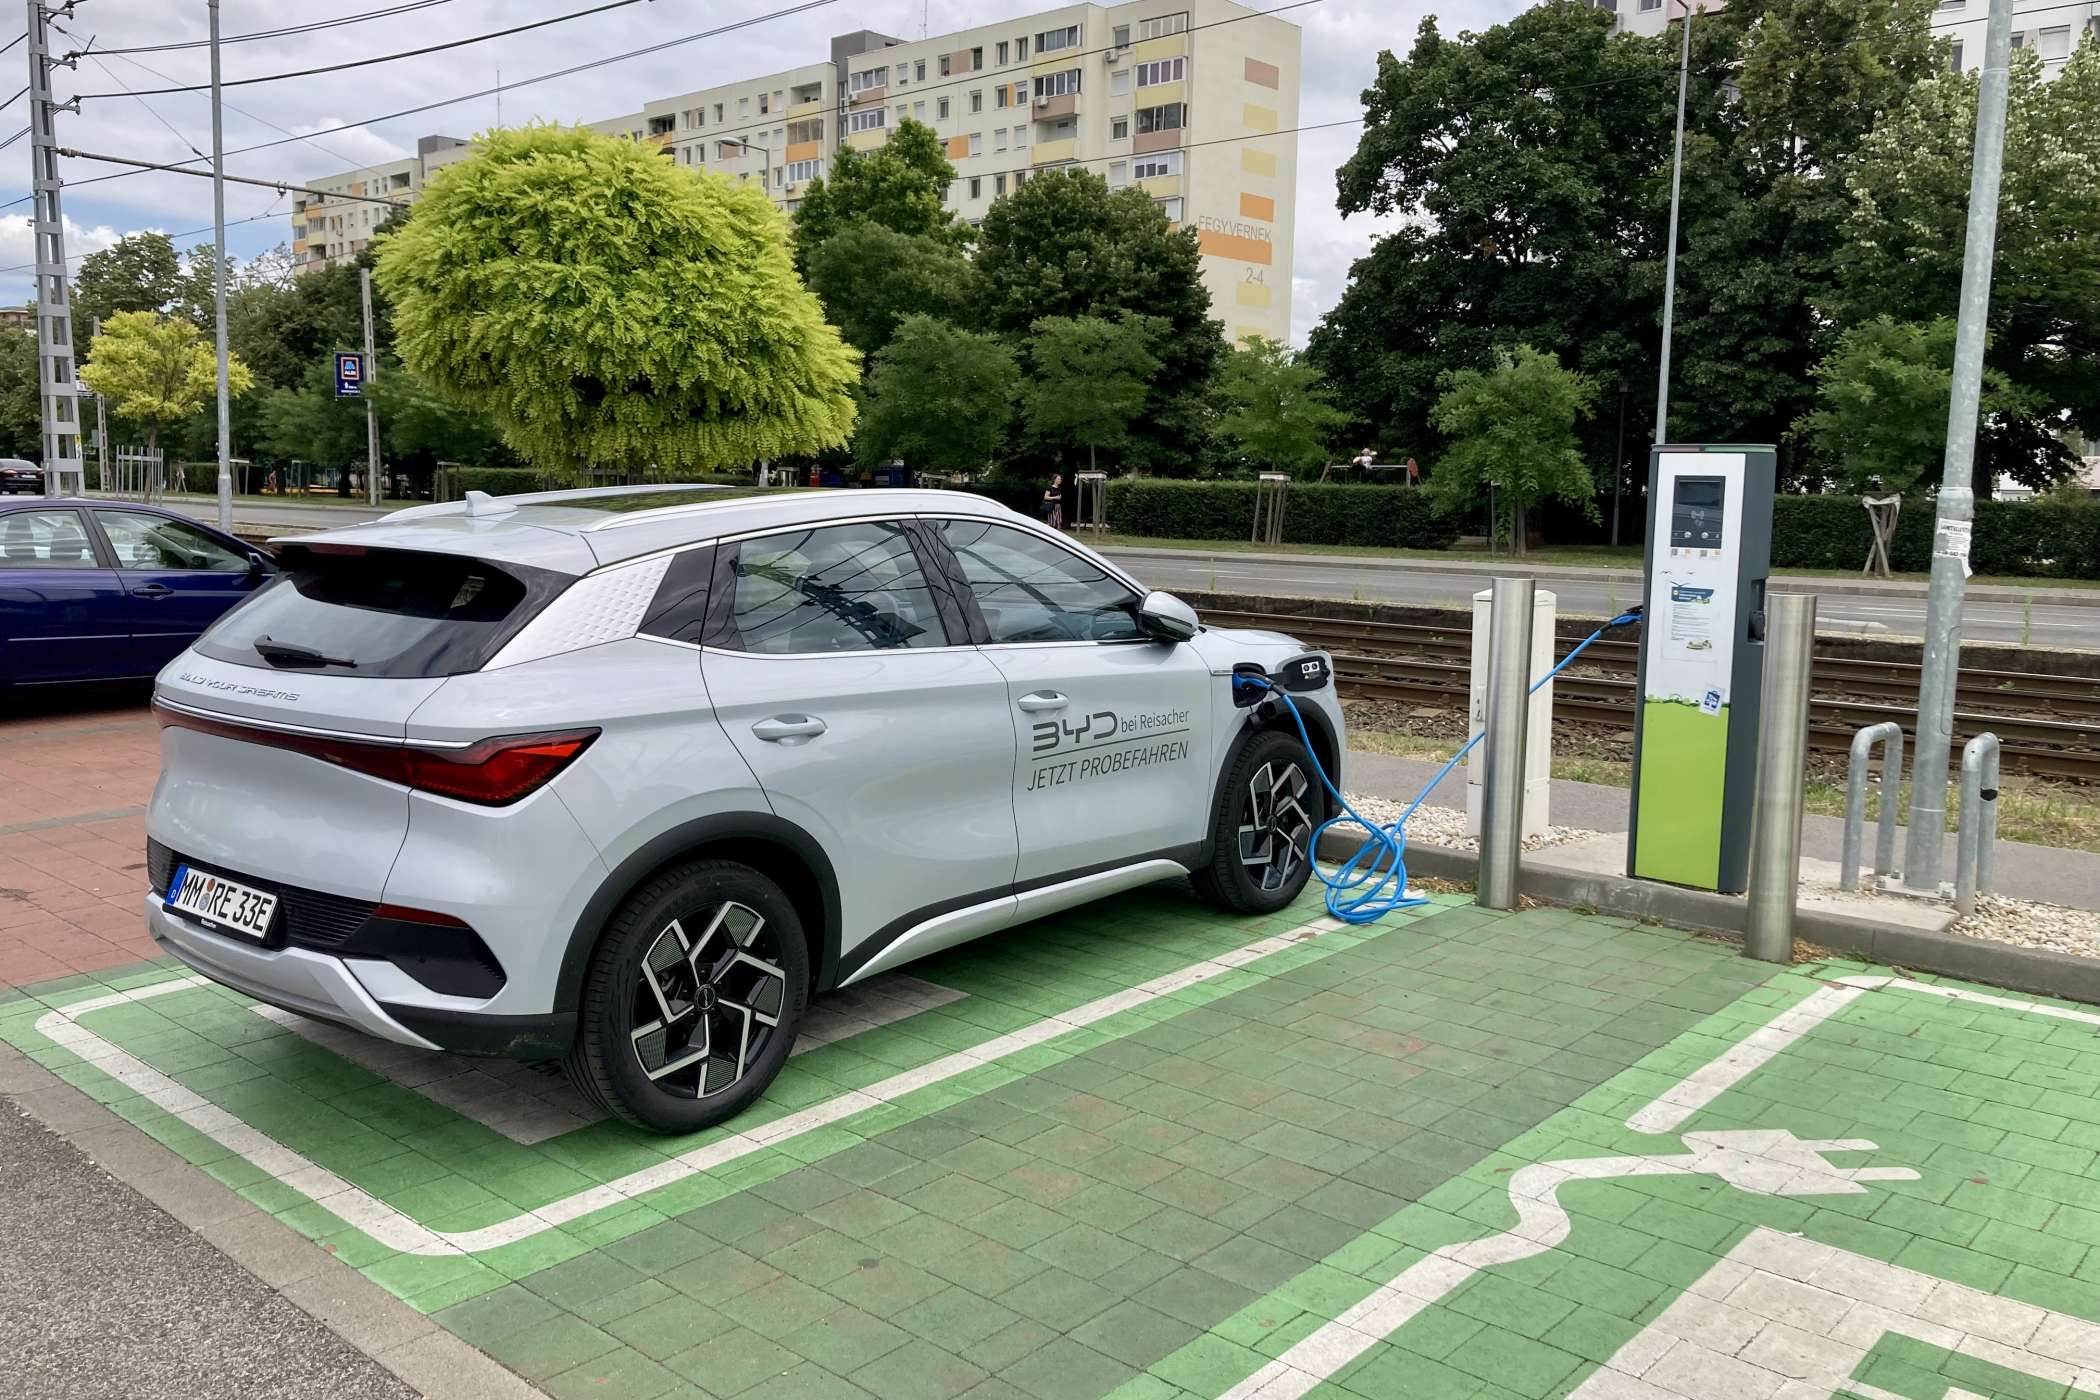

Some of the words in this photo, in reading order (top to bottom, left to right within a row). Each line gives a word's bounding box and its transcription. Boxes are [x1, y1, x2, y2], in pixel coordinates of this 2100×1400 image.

[1198, 215, 1271, 241] FEGYVERNEK
[1246, 267, 1264, 285] 2-4
[238, 685, 300, 701] DREAMS
[1032, 711, 1118, 752] BYD
[1120, 715, 1137, 733] bei
[1140, 707, 1190, 730] Reisacher
[1027, 761, 1077, 791] JETZT
[1079, 741, 1189, 780] PROBEFAHREN
[176, 872, 207, 908] MM
[206, 882, 237, 919] RE
[232, 890, 273, 932] 33E
